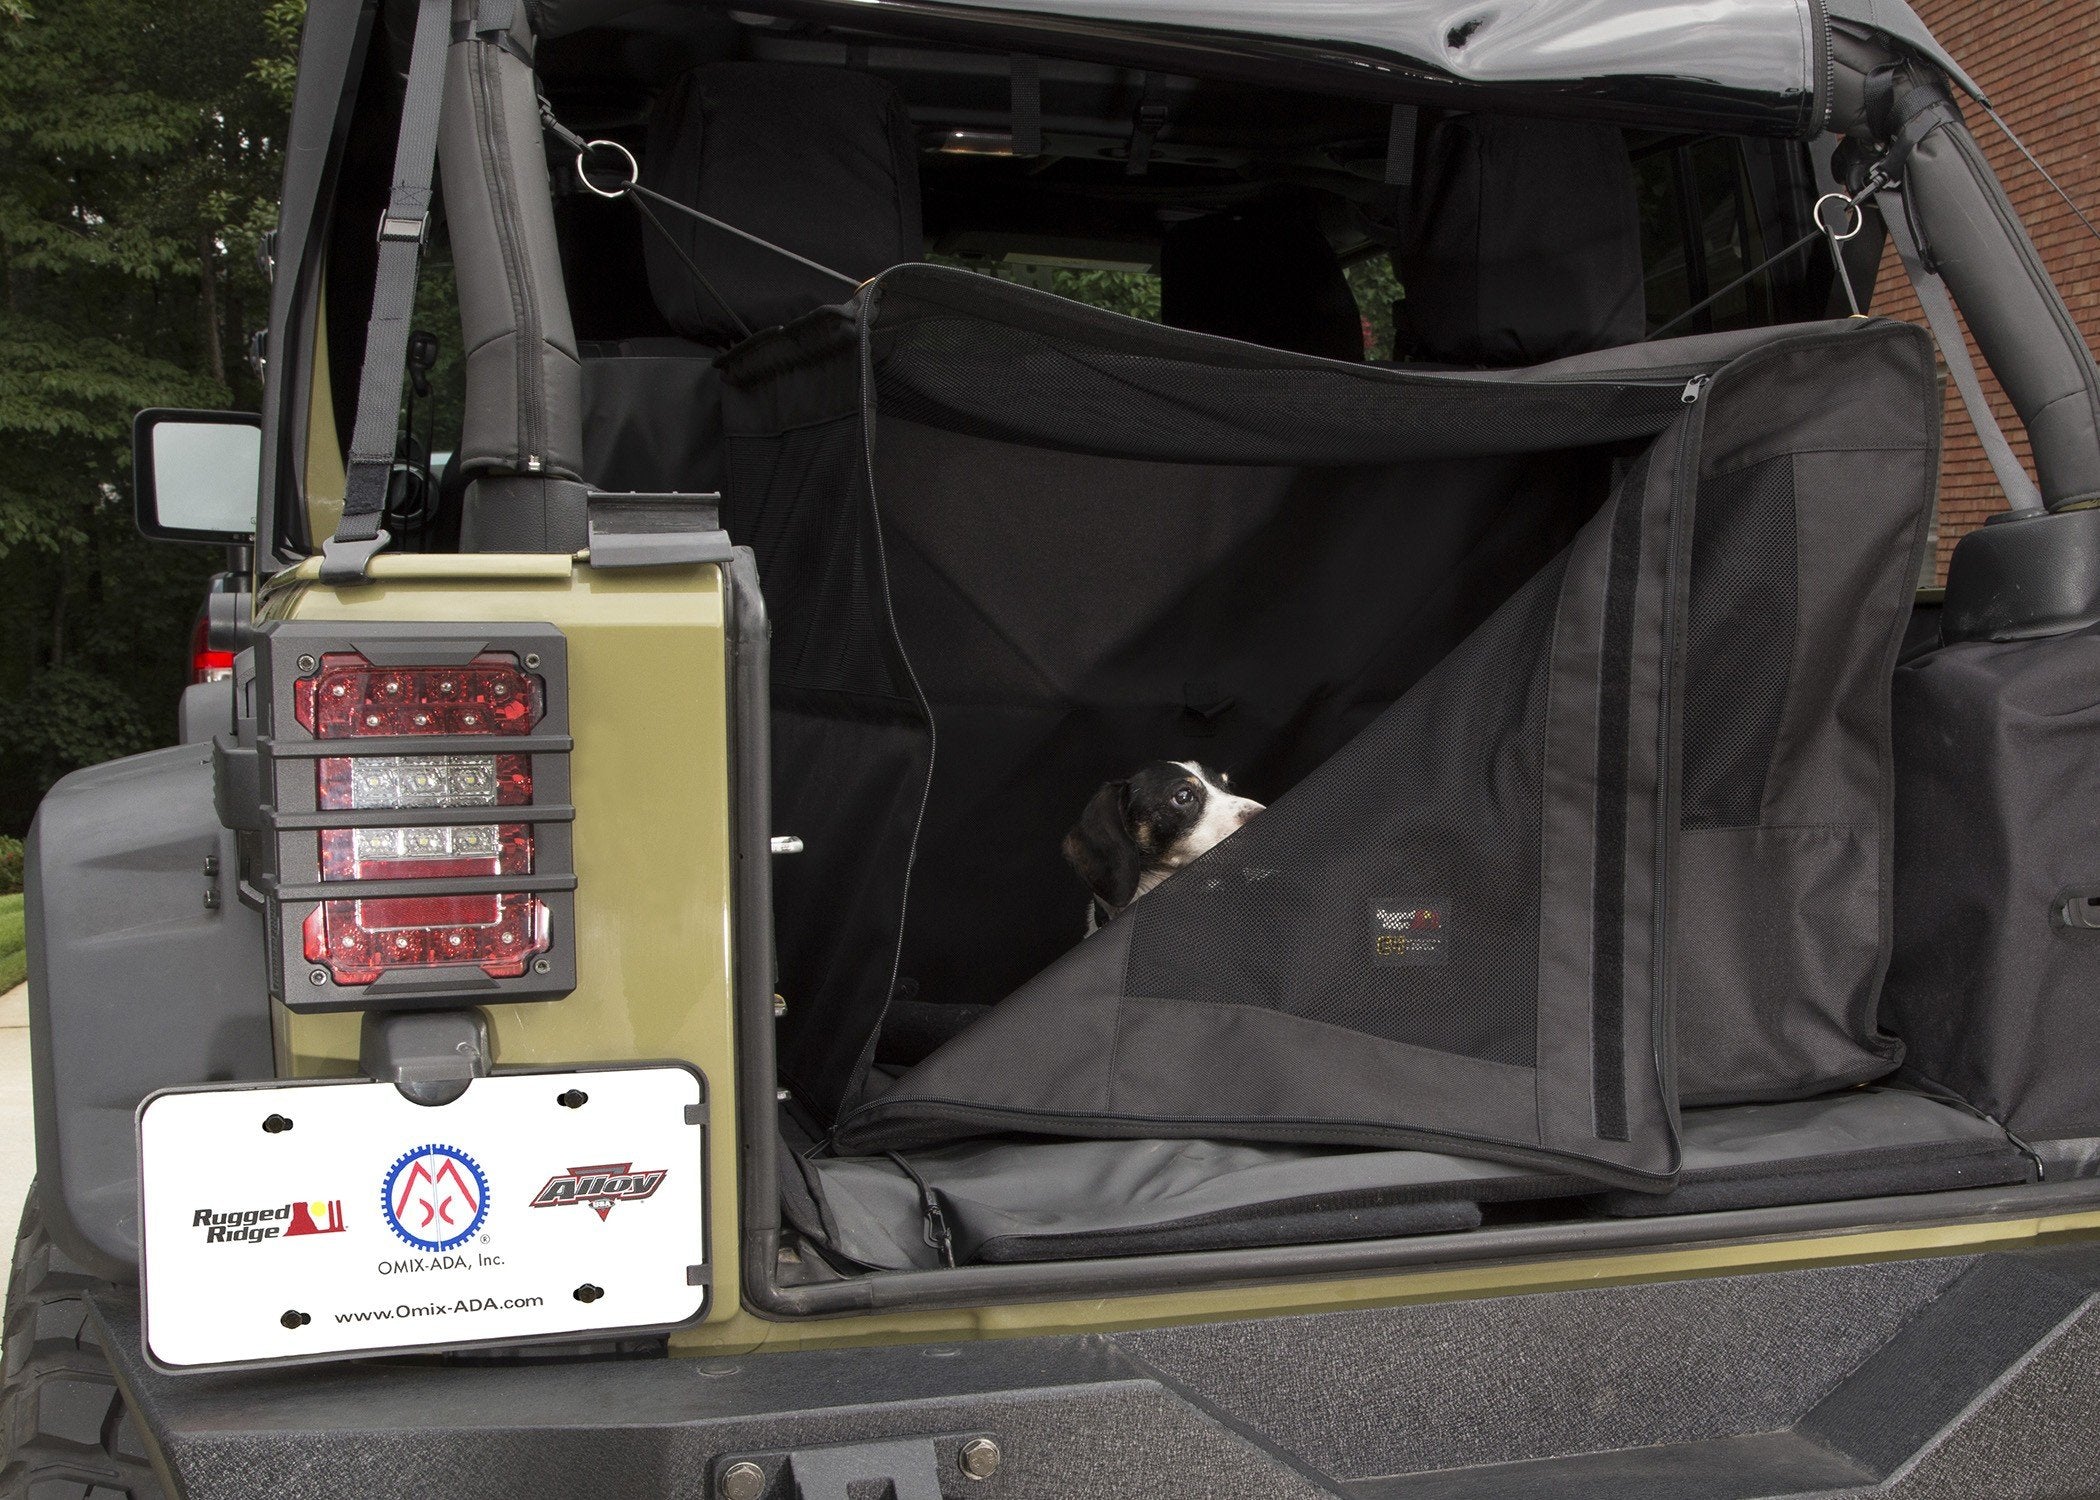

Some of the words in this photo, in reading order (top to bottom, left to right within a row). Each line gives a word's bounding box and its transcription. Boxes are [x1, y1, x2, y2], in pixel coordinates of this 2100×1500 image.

[537, 1173, 660, 1202] Alloy
[193, 1204, 291, 1227] Rugged
[207, 1216, 280, 1244] Ridge
[378, 1255, 472, 1275] OMIX-ADA,
[478, 1253, 505, 1267] Inc.
[335, 1297, 544, 1323] www.Omix-ADA.com
